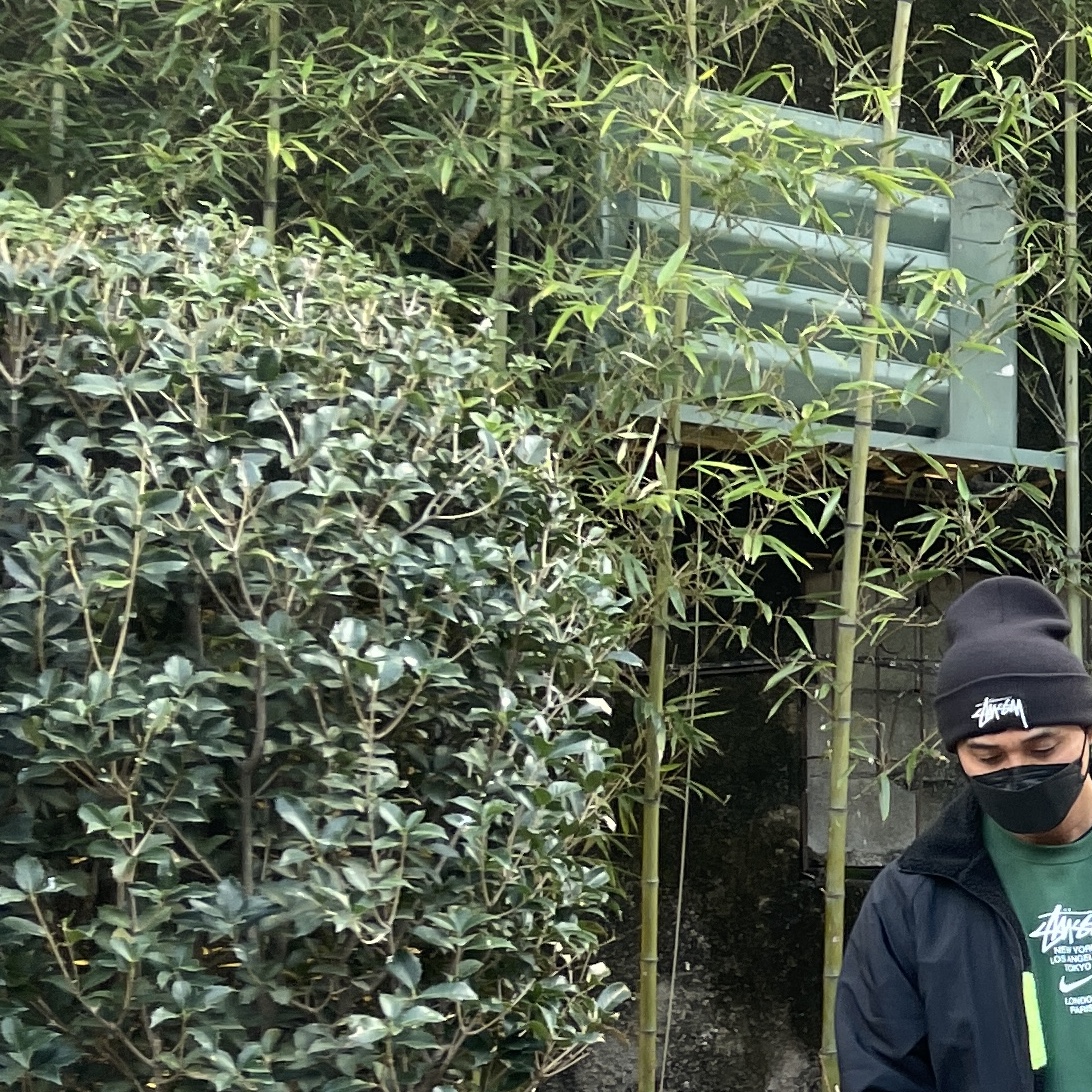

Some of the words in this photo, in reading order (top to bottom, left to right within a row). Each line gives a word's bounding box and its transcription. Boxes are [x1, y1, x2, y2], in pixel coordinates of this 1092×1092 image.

[1054, 946, 1072, 954] NEW
[1050, 954, 1066, 965] LOS
[1064, 962, 1092, 972] TOKYO
